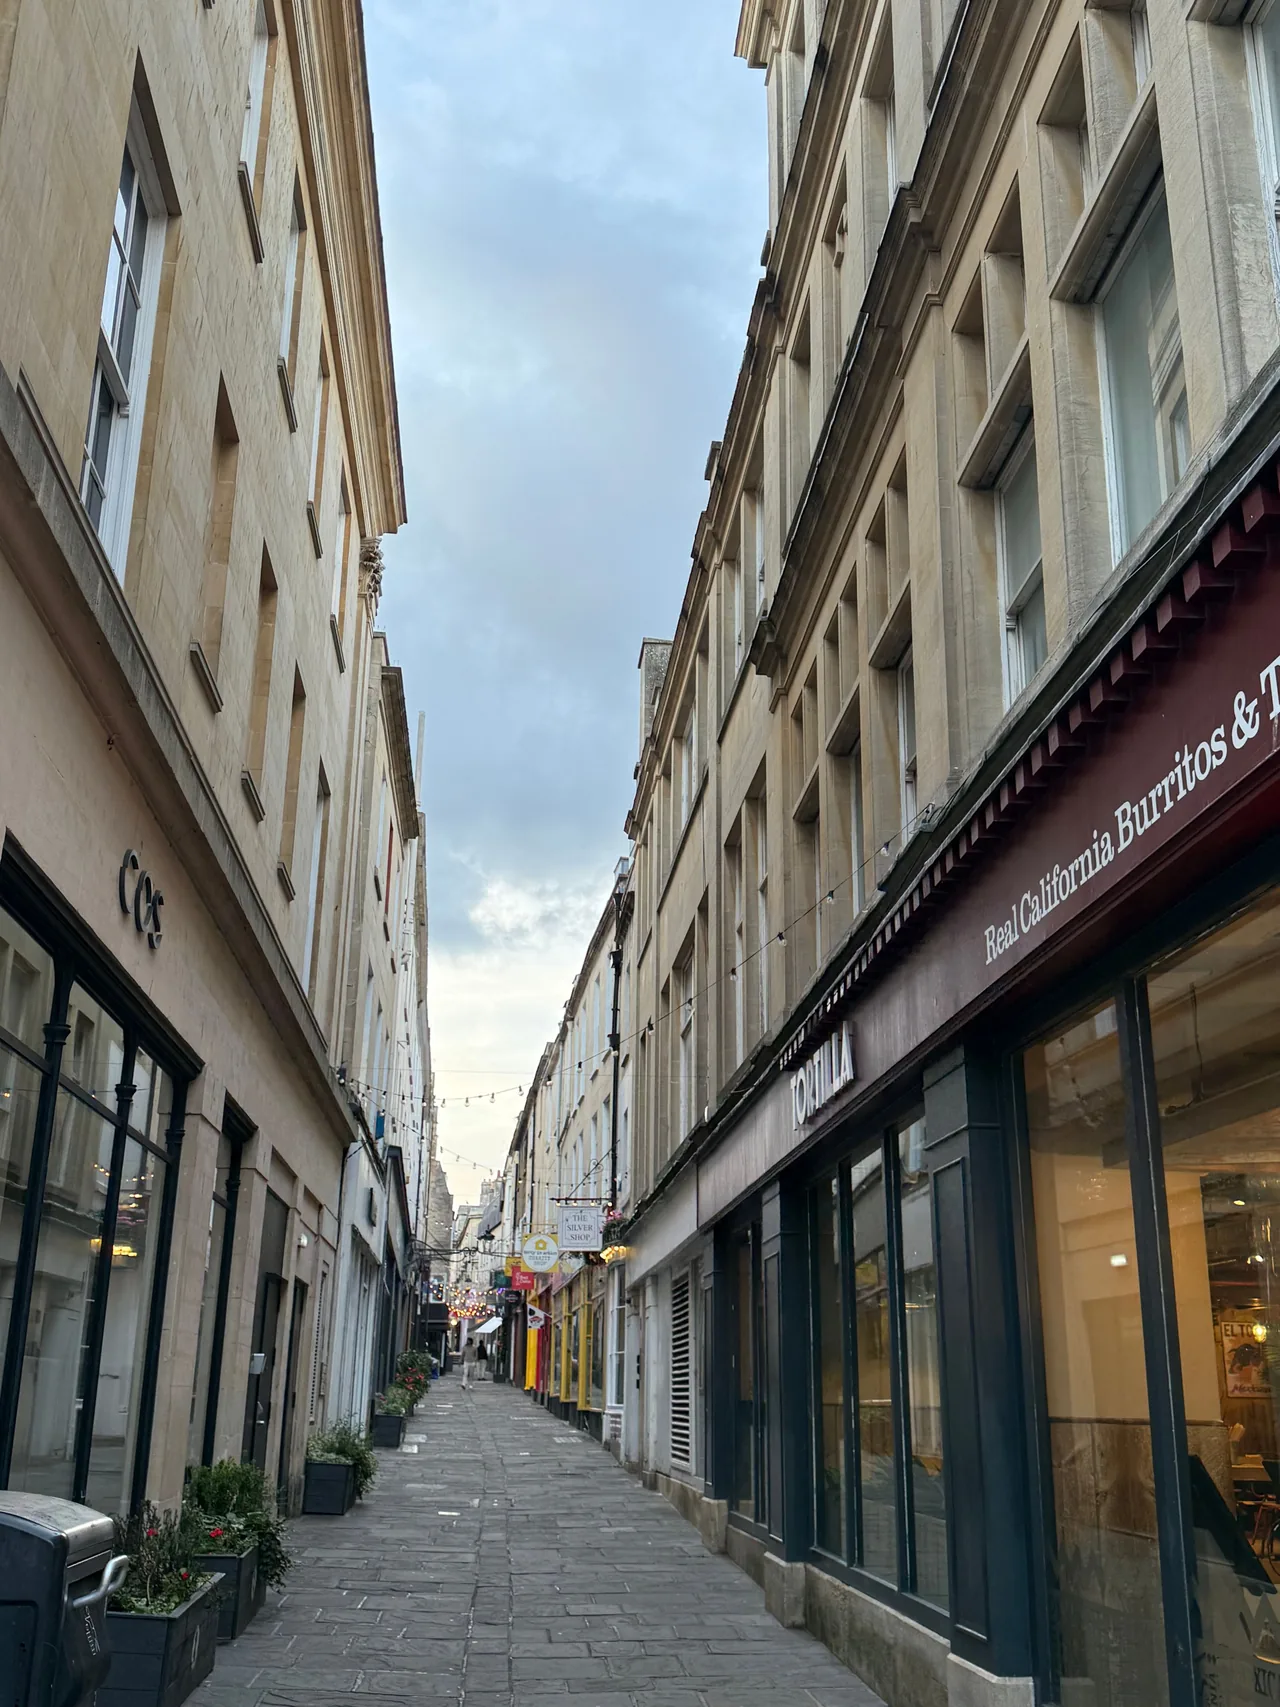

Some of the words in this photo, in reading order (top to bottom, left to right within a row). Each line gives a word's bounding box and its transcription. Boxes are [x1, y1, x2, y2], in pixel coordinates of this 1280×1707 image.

[984, 904, 1019, 965] Real
[1020, 829, 1115, 934] California
[1114, 724, 1228, 849] Burritos
[1231, 691, 1260, 749] &
[119, 848, 165, 949] COS
[790, 1021, 854, 1131] TORTILLA
[570, 1233, 590, 1241] SHOP
[572, 1214, 588, 1222] THE
[1224, 1323, 1237, 1338] EL
